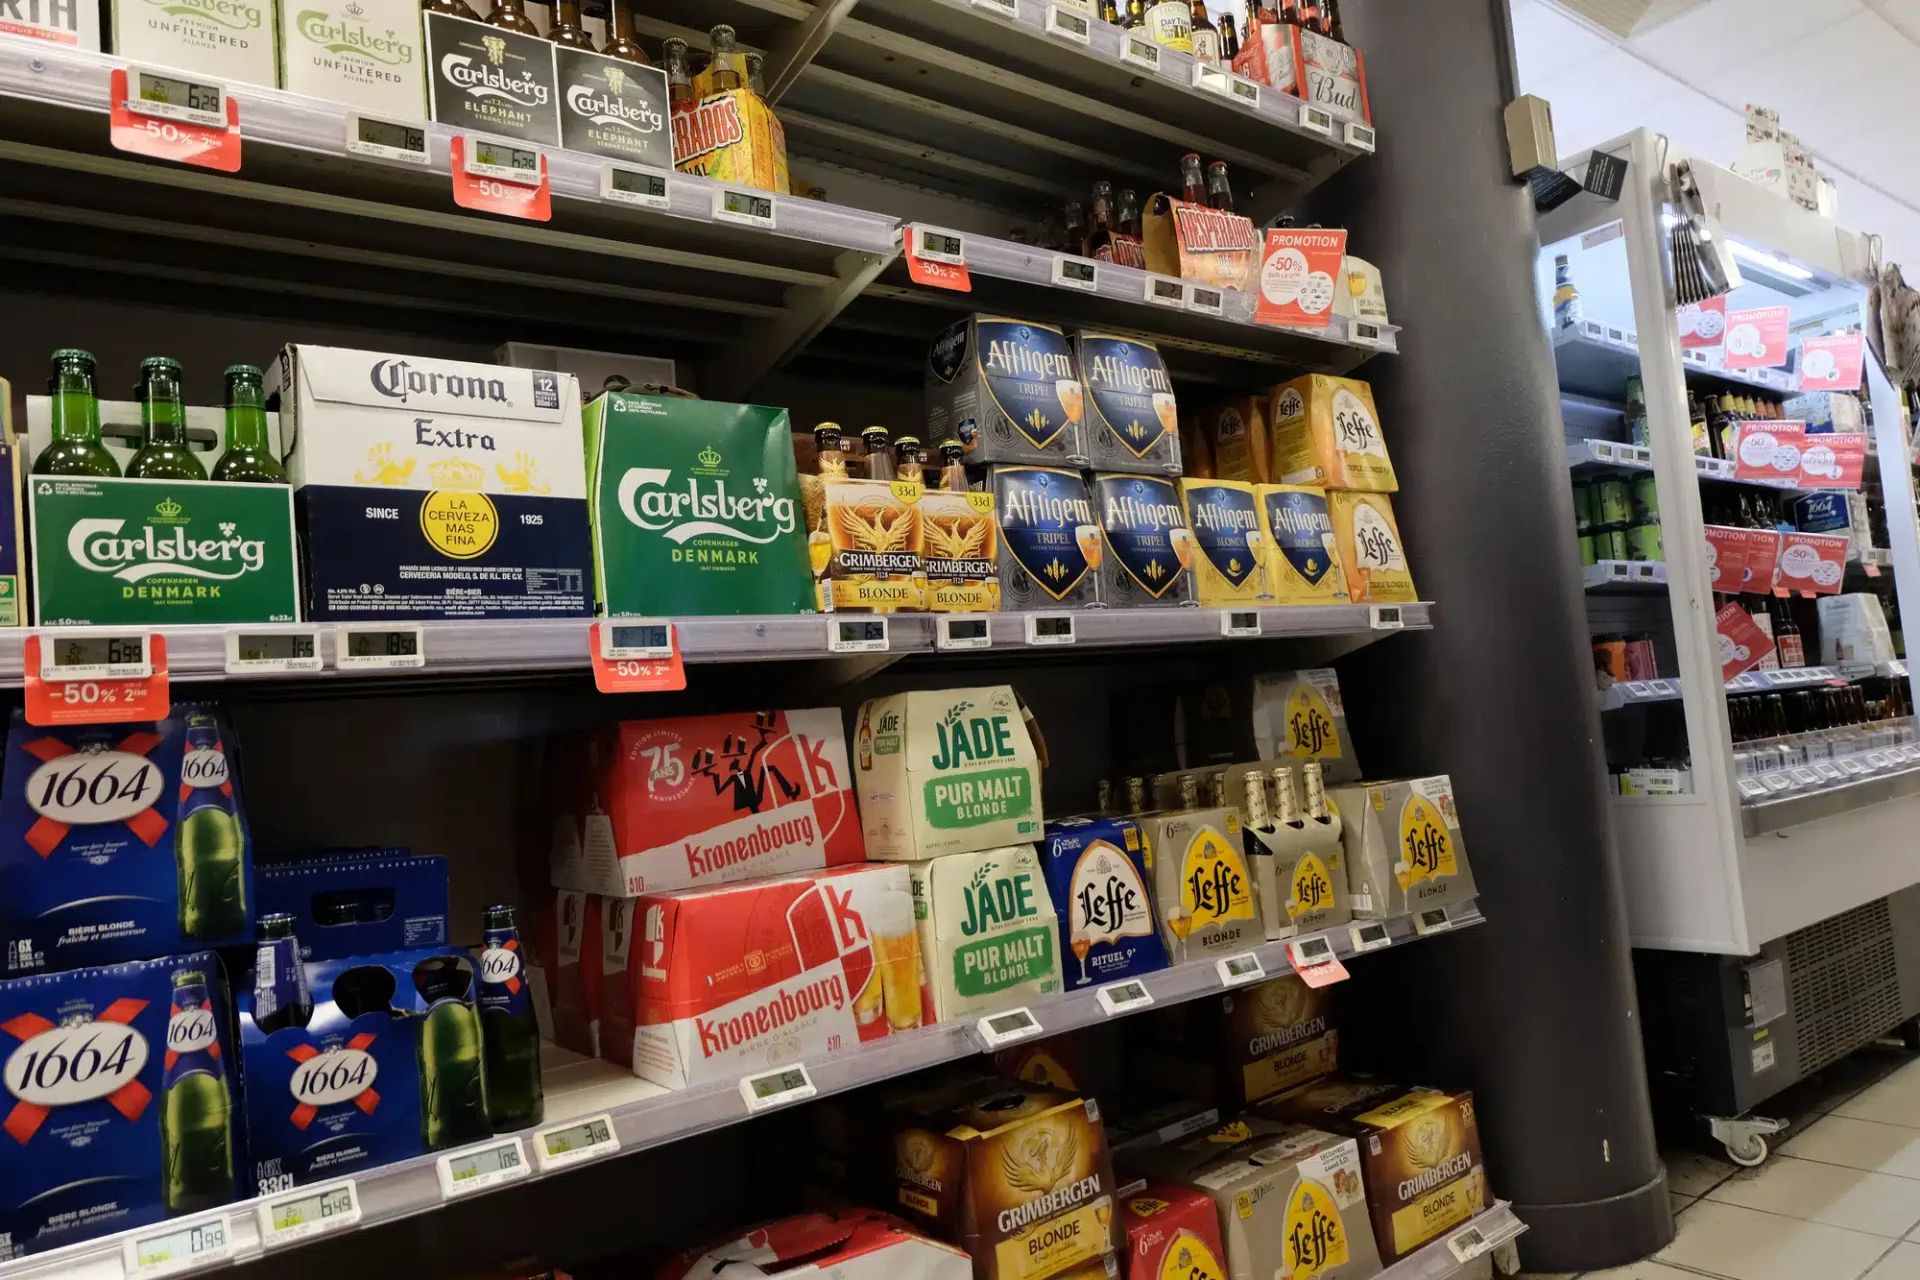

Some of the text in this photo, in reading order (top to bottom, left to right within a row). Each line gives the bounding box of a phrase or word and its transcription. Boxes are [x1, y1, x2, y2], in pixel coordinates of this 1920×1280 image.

[148, 19, 249, 49] UNFILTERED
[297, 10, 412, 65] Carlsberg
[313, 57, 402, 84] UNFILTERED
[441, 53, 549, 105] Carlsberg
[1311, 71, 1357, 111] Bud
[465, 101, 532, 123] ELEPHANT
[567, 84, 663, 132] Carlsberg
[475, 113, 524, 128] STRONG LAGER
[588, 129, 649, 149] ELEPHANT
[597, 141, 641, 154] STRONG LAGER
[1178, 208, 1254, 251] DESPERADOS
[1271, 234, 1339, 248] PROMOTION
[1270, 257, 1302, 271] -50%
[1731, 309, 1785, 322] PROMOTION
[986, 340, 1072, 378] Affligem
[370, 359, 507, 403] Corona
[1092, 355, 1167, 391] Affligem
[538, 378, 553, 392] 12
[1017, 382, 1051, 396] TRIPEL
[1118, 395, 1148, 408] TRIPEL
[1279, 397, 1301, 418] Leffe
[413, 417, 496, 451] Extra
[1336, 411, 1374, 450] Leffe
[1746, 423, 1800, 432] PROMOTION
[617, 467, 796, 534] Carlsberg
[898, 485, 916, 497] 33cl
[972, 496, 990, 508] 33cl
[366, 507, 399, 520] SINCE
[428, 510, 490, 522] CERVEZA
[450, 500, 467, 510] LA
[1005, 490, 1093, 528] Affligem
[1107, 496, 1184, 531] Affligem
[1808, 500, 1832, 513] 1664
[445, 523, 475, 534] MAS
[519, 514, 543, 525] 1925
[1195, 503, 1257, 535] Affligem
[1275, 507, 1331, 535] Affligem
[67, 518, 265, 573] Carlsberg
[445, 535, 476, 546] FINA
[693, 539, 739, 547] COPENHAGEN
[1036, 532, 1071, 545] TRIPEL
[1136, 535, 1166, 547] TRIPEL
[1217, 537, 1246, 547] BLONDE
[1294, 537, 1321, 547] BLONDE
[1357, 527, 1395, 567] Leffe
[1789, 535, 1843, 548] PROMOTION
[671, 549, 759, 565] DENMARK
[839, 553, 921, 569] GRIMBERGEN
[400, 571, 441, 579] CERVECERIA
[443, 572, 471, 580] MODELO,
[122, 586, 222, 599] DENMARK
[859, 588, 909, 600] BLONDE
[936, 592, 982, 603] BLONDE
[877, 715, 899, 735] JADE
[1290, 708, 1330, 754] Leffe
[932, 715, 1015, 770] JADE
[182, 756, 227, 779] 1664
[640, 742, 685, 792] 75
[652, 766, 674, 781] ANS
[797, 734, 838, 793] K
[40, 759, 151, 810] 1664
[935, 775, 1023, 807] PUR MALT
[957, 801, 1007, 820] BLONDE
[1166, 822, 1175, 839] 6
[684, 814, 814, 879] Kronenbourg
[1052, 838, 1062, 858] 6
[1406, 823, 1446, 874] Leffe
[327, 864, 370, 873] FRANCE
[379, 859, 436, 869] GARANTIE
[1188, 860, 1241, 918] Leffe
[1296, 872, 1327, 906] Leffe
[1418, 883, 1448, 898] BLONDE
[960, 873, 1037, 936] JADE
[1077, 876, 1136, 933] Leffe
[825, 884, 867, 949] K
[1303, 913, 1326, 924] BLONDE
[68, 920, 136, 936] BIÈRE BLONDE
[1202, 928, 1241, 946] BLONDE
[18, 939, 32, 953] 6X
[964, 934, 1044, 975] PUR MALT
[1091, 952, 1124, 967] RITUEL
[74, 966, 129, 980] FRANCE
[984, 962, 1030, 985] BLONDE
[696, 974, 845, 1059] Kronenbourg
[169, 1014, 215, 1044] 1664
[1250, 1016, 1325, 1055] GRIMBERGEN
[18, 1031, 136, 1092] 1664
[1273, 1050, 1308, 1072] BLONDE
[299, 1055, 369, 1096] 1664
[1459, 1103, 1471, 1119] 20
[1398, 1150, 1472, 1201] GRIMBERGEN
[48, 1201, 118, 1224] BIÈRE BLONDE
[998, 1173, 1101, 1233] GRIMBERGEN
[1423, 1191, 1456, 1218] BLONDE
[1029, 1220, 1081, 1255] BLONDE
[1139, 1234, 1148, 1256] 6
[1289, 1210, 1336, 1271] Leffe
